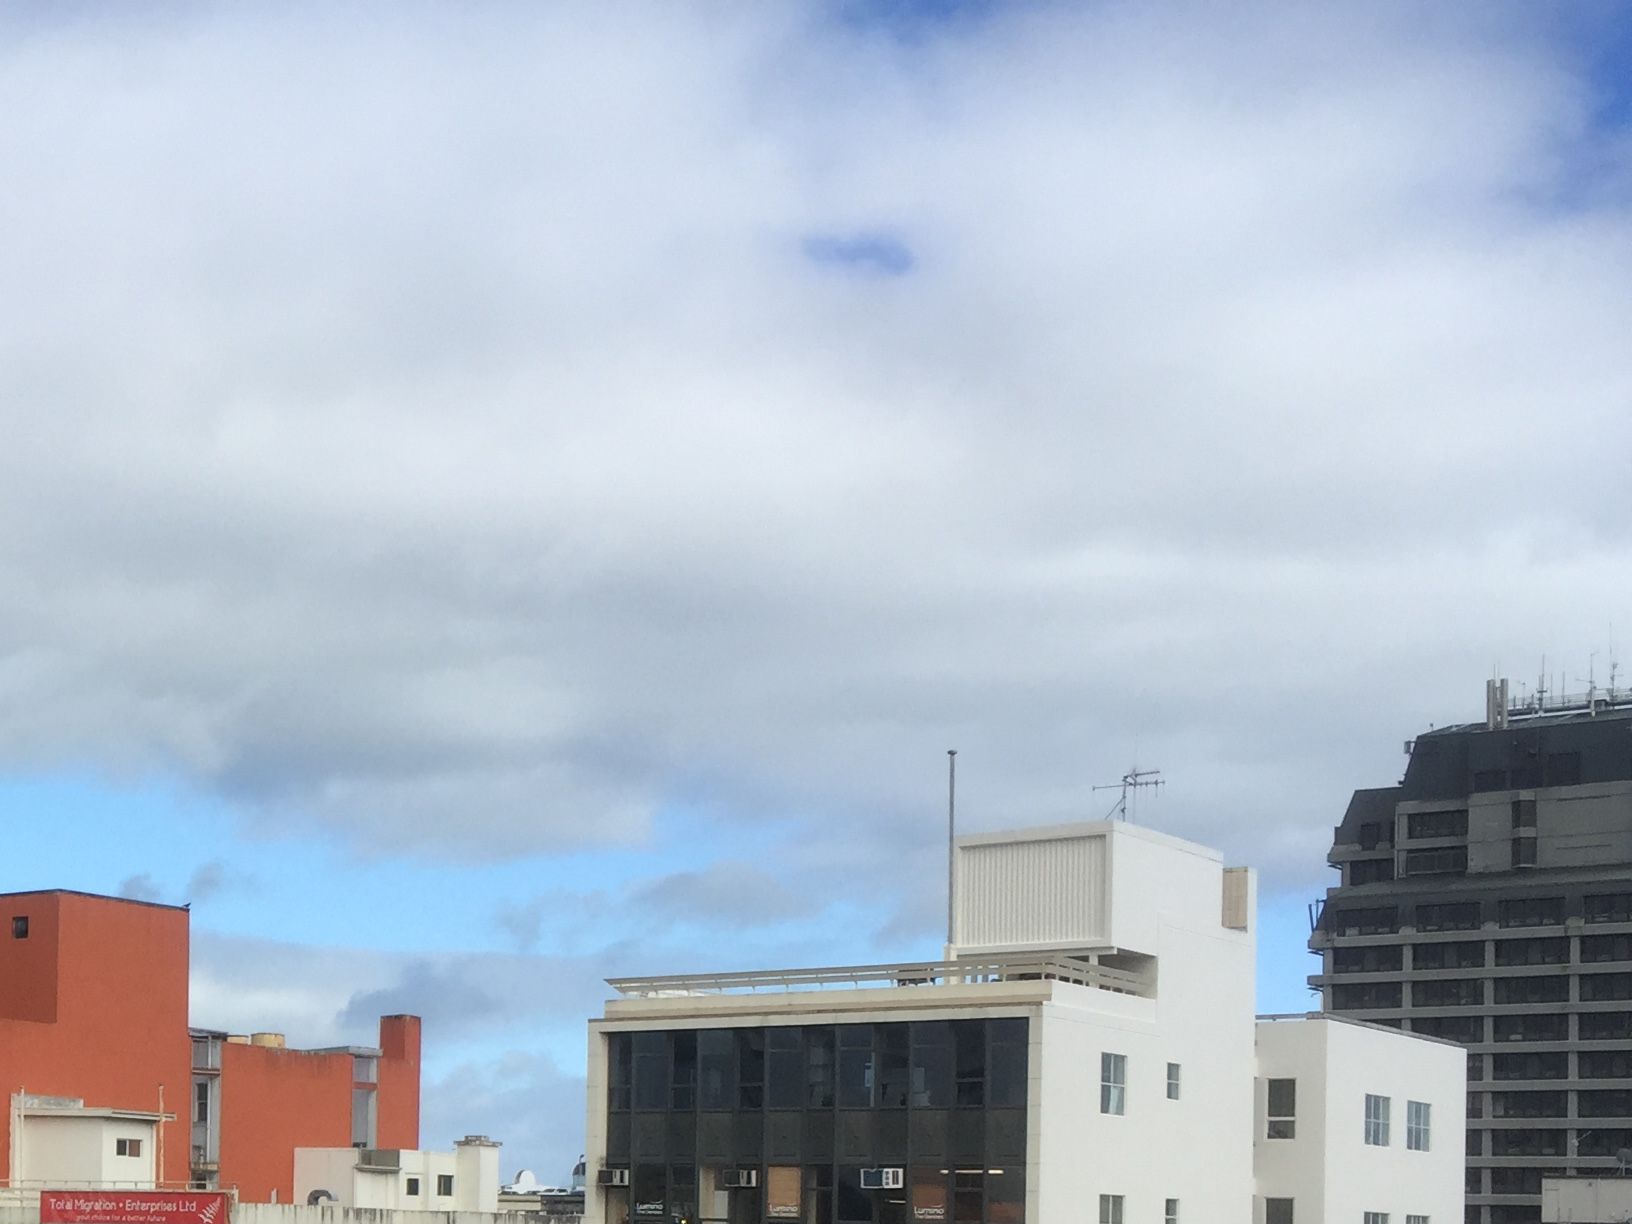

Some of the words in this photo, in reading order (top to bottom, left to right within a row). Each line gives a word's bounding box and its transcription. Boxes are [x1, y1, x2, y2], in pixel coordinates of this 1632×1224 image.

[50, 1199, 73, 1210] Total
[75, 1199, 116, 1213] Migration
[125, 1200, 177, 1213] Enterprises
[179, 1200, 196, 1211] Ltd
